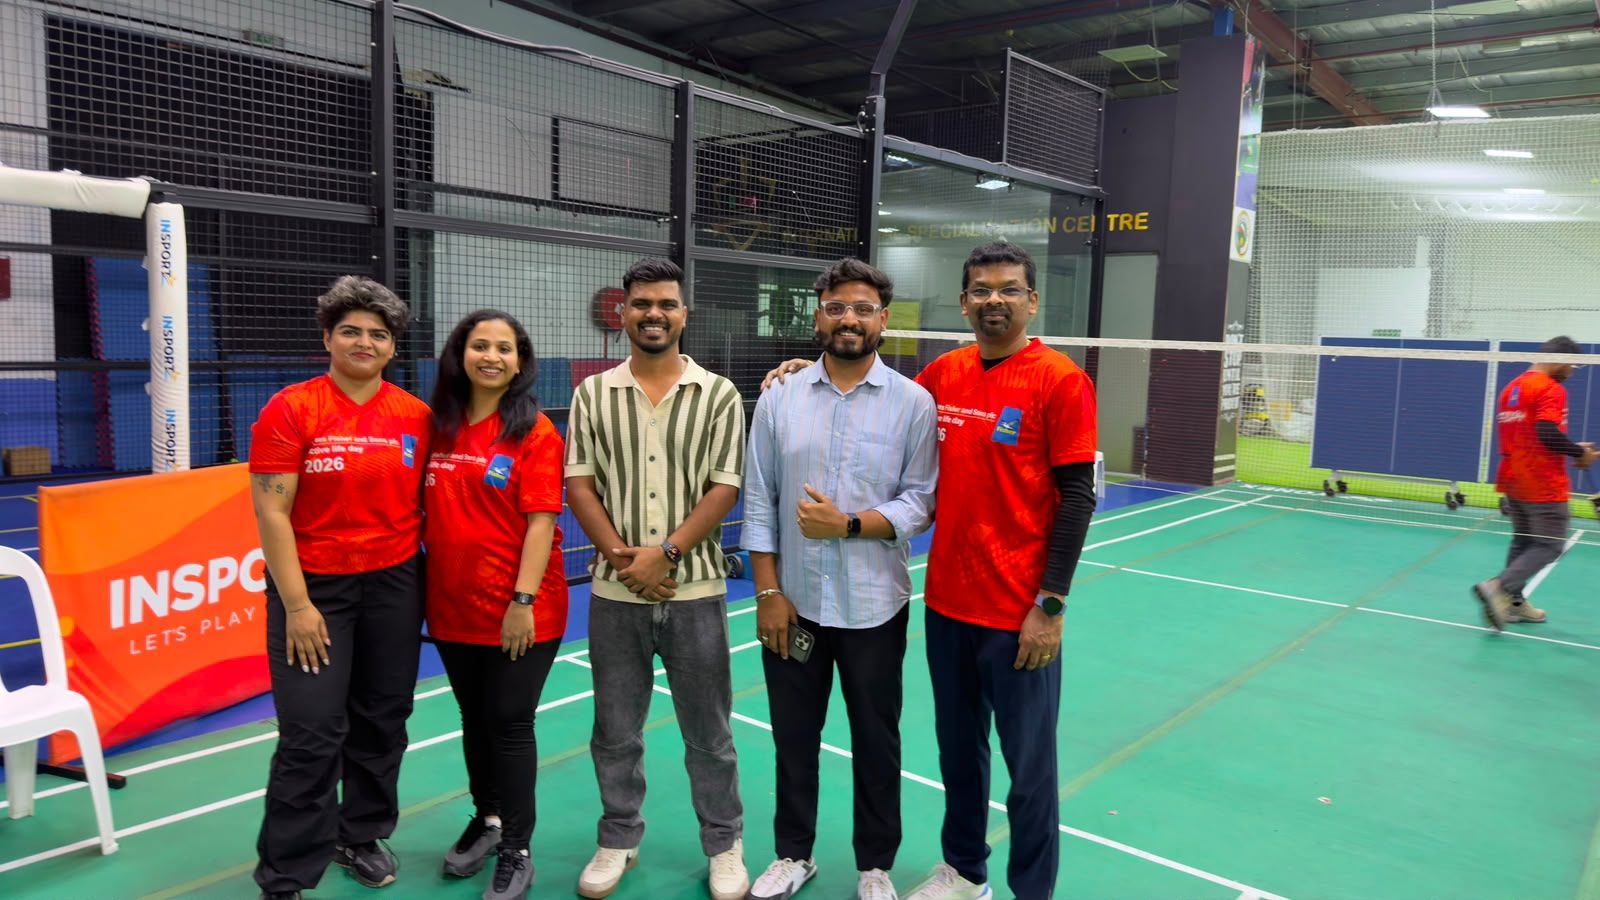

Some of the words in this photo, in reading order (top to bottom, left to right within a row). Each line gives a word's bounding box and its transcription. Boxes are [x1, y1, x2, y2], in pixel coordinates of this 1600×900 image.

[304, 456, 345, 473] 2026
[130, 626, 187, 655] LET'S
[201, 606, 256, 635] PLAY
